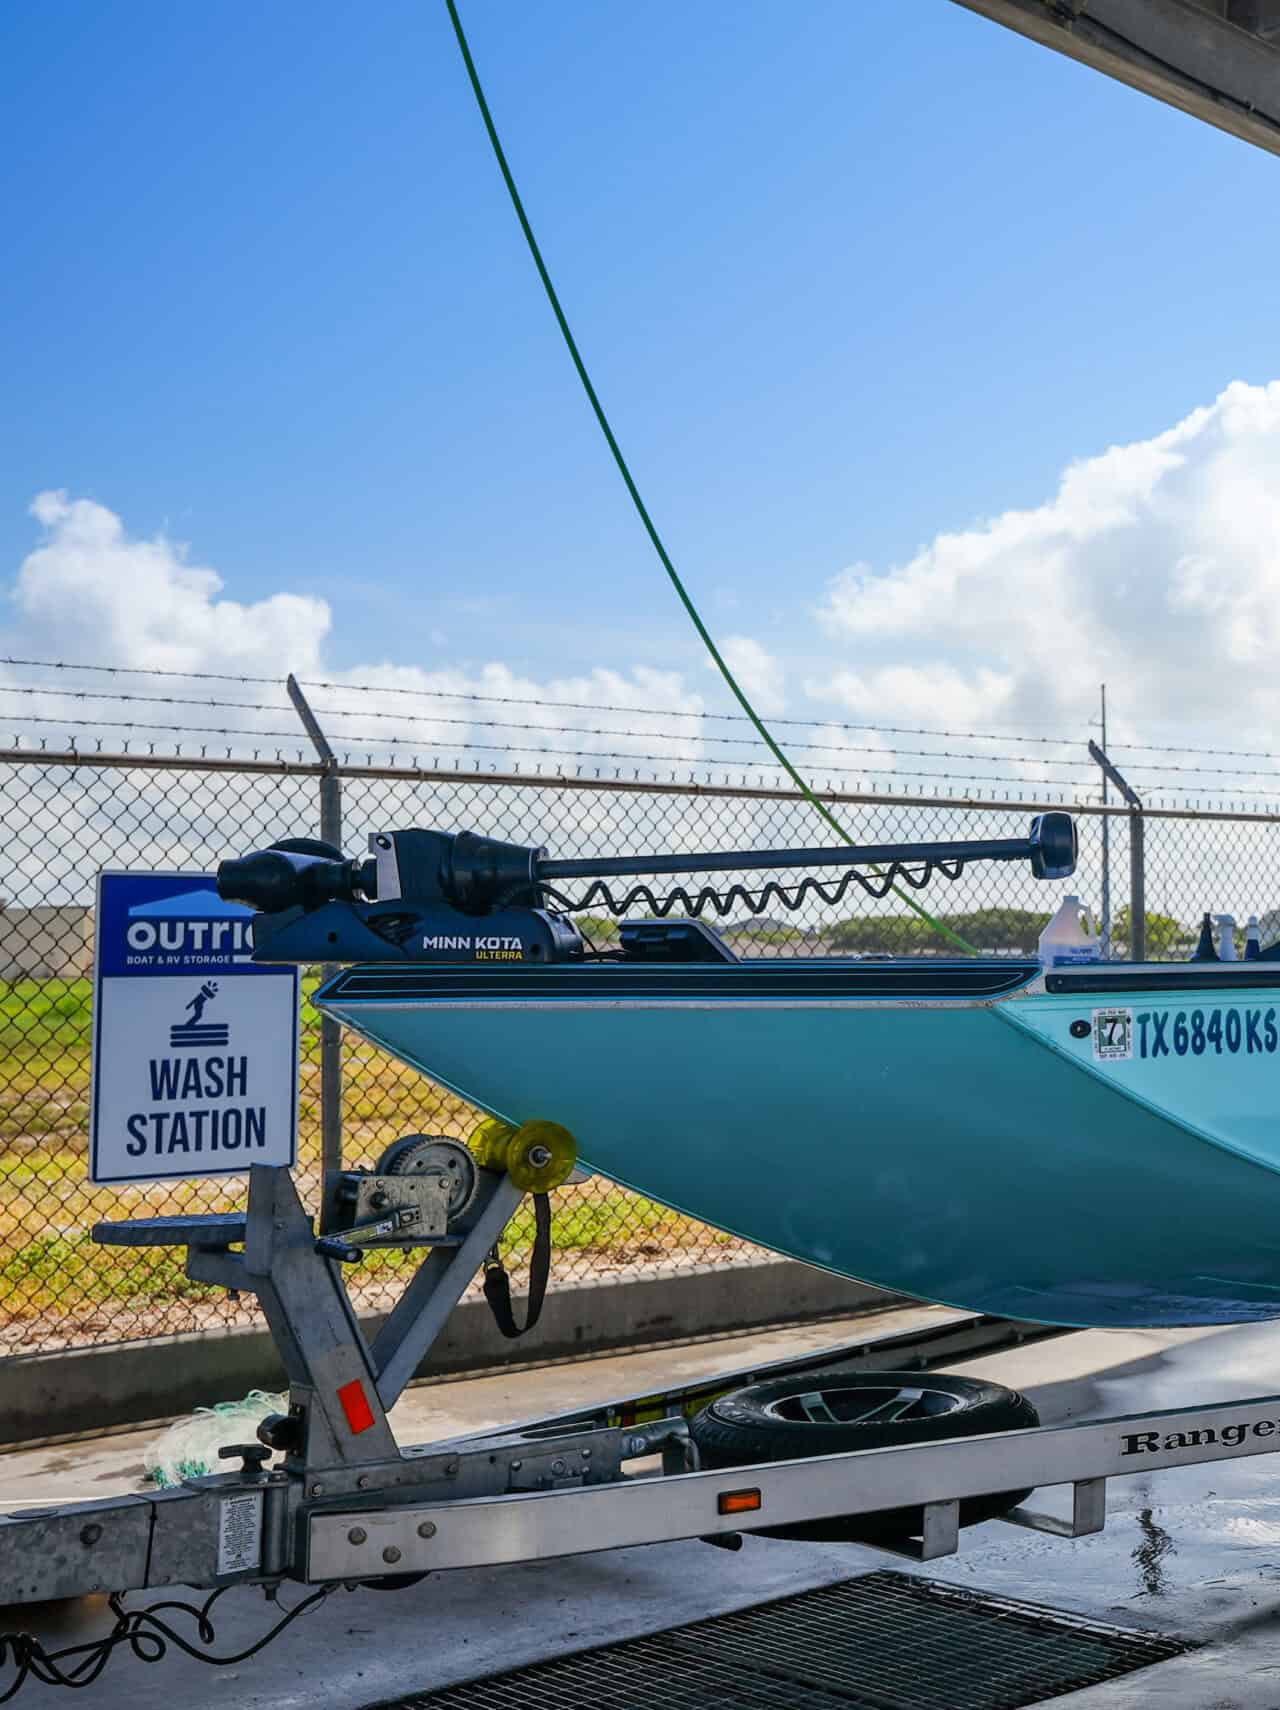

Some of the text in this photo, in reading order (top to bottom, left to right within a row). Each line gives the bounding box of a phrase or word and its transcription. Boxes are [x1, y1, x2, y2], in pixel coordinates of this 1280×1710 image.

[423, 936, 523, 950] MINN KOTA
[127, 955, 230, 965] BOAT & RV STORAGE
[476, 951, 523, 960] ULTERRA
[1104, 1017, 1119, 1046] 7
[150, 1056, 247, 1101] WASH
[126, 1107, 266, 1156] STATION
